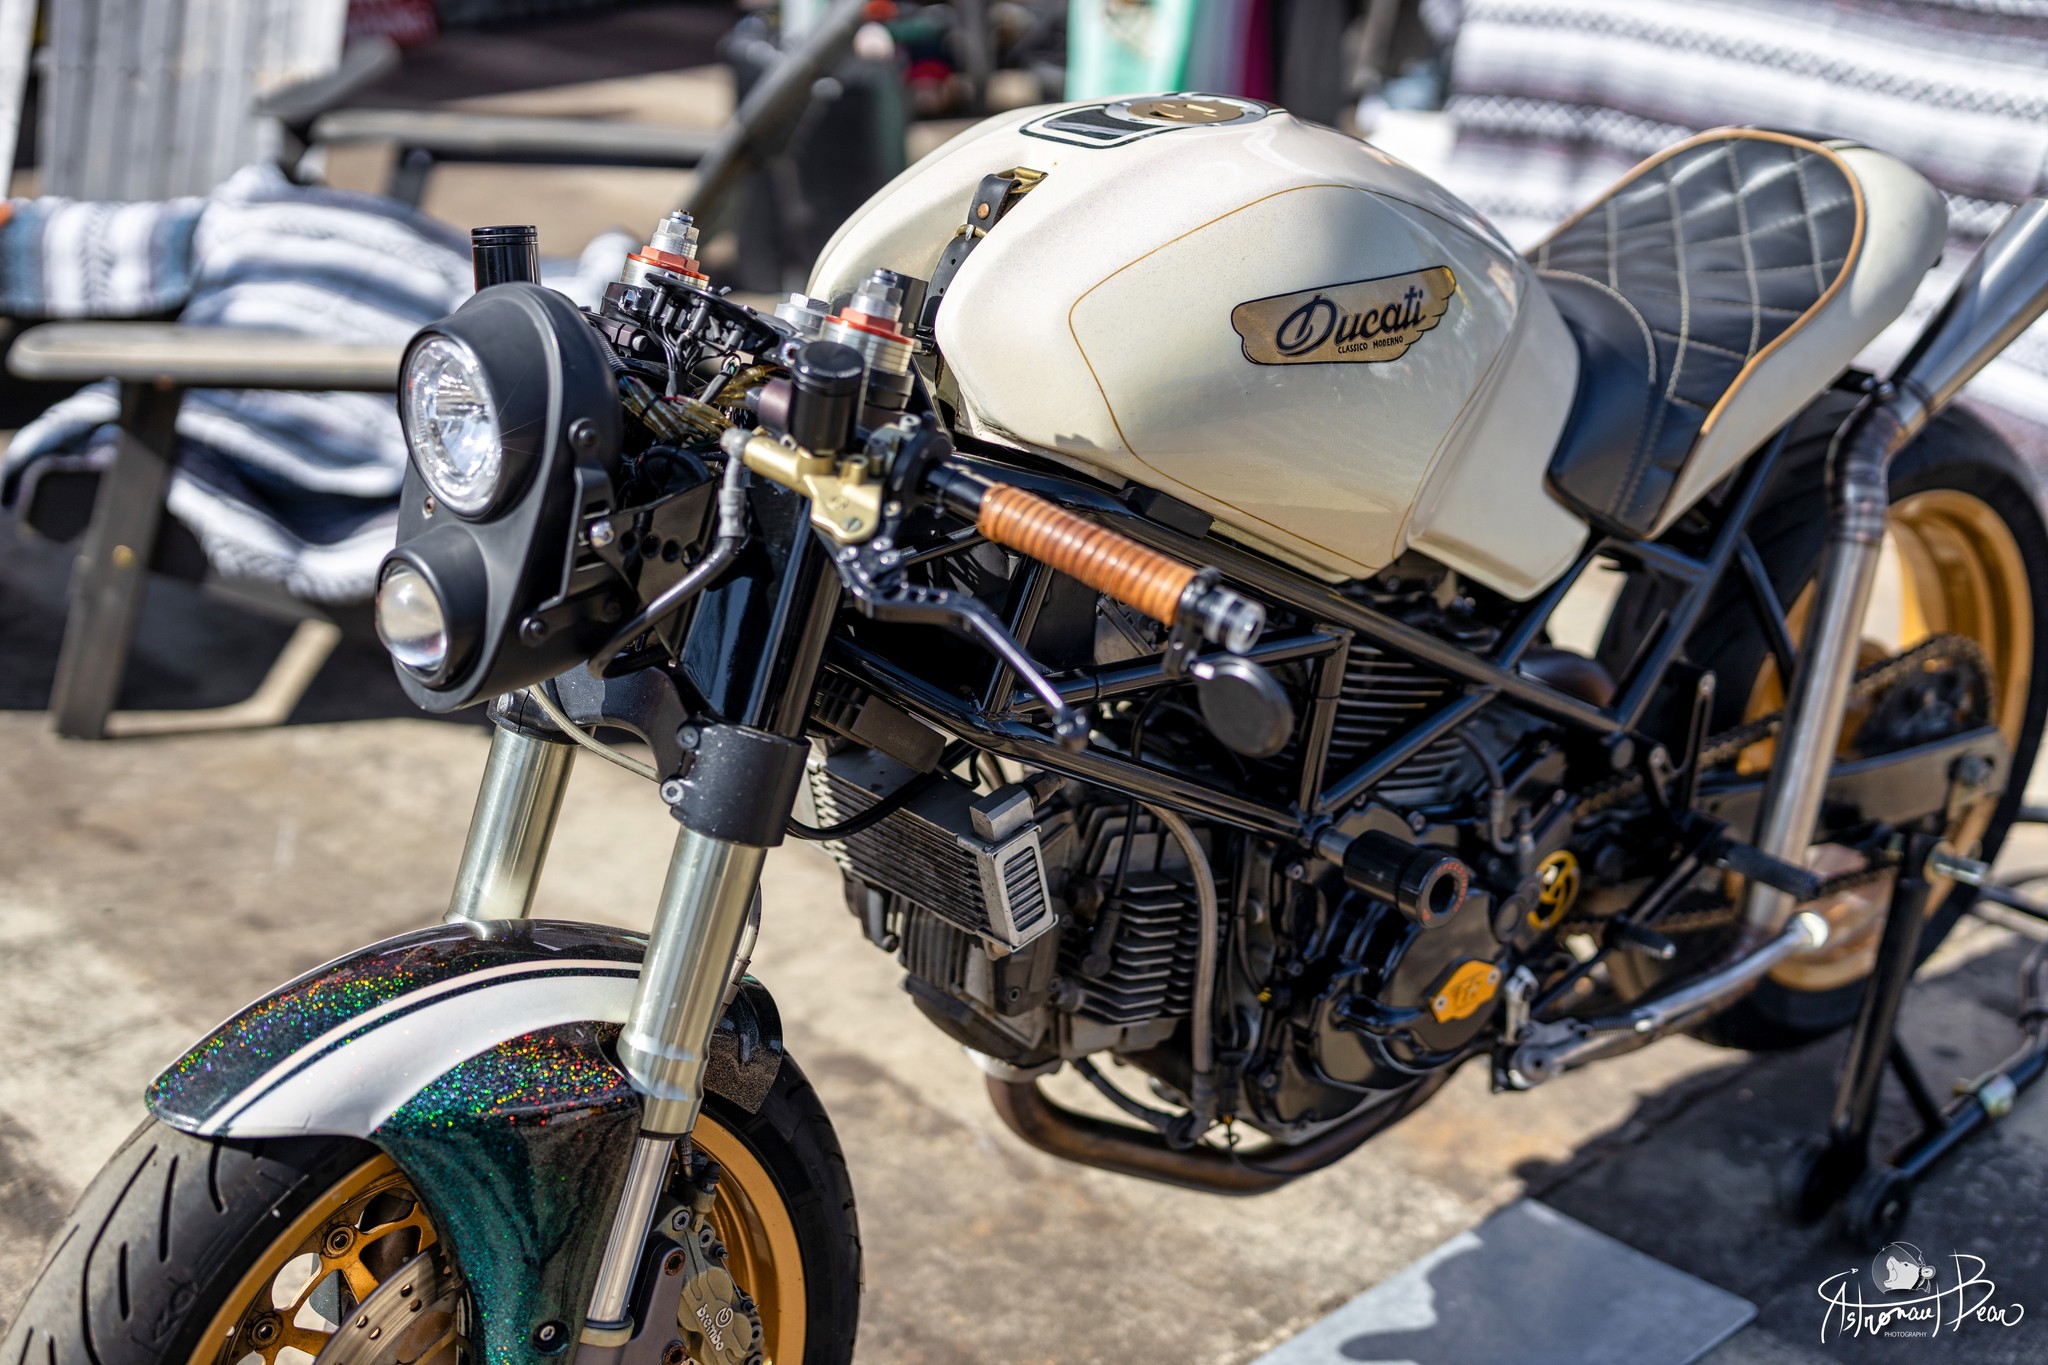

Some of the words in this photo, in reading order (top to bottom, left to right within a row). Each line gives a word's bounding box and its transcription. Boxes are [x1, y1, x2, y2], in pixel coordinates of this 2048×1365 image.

[1275, 285, 1426, 356] Ducati
[1337, 342, 1368, 354] CLASSICO
[1372, 335, 1404, 349] MODERNO
[696, 1303, 724, 1351] brembo
